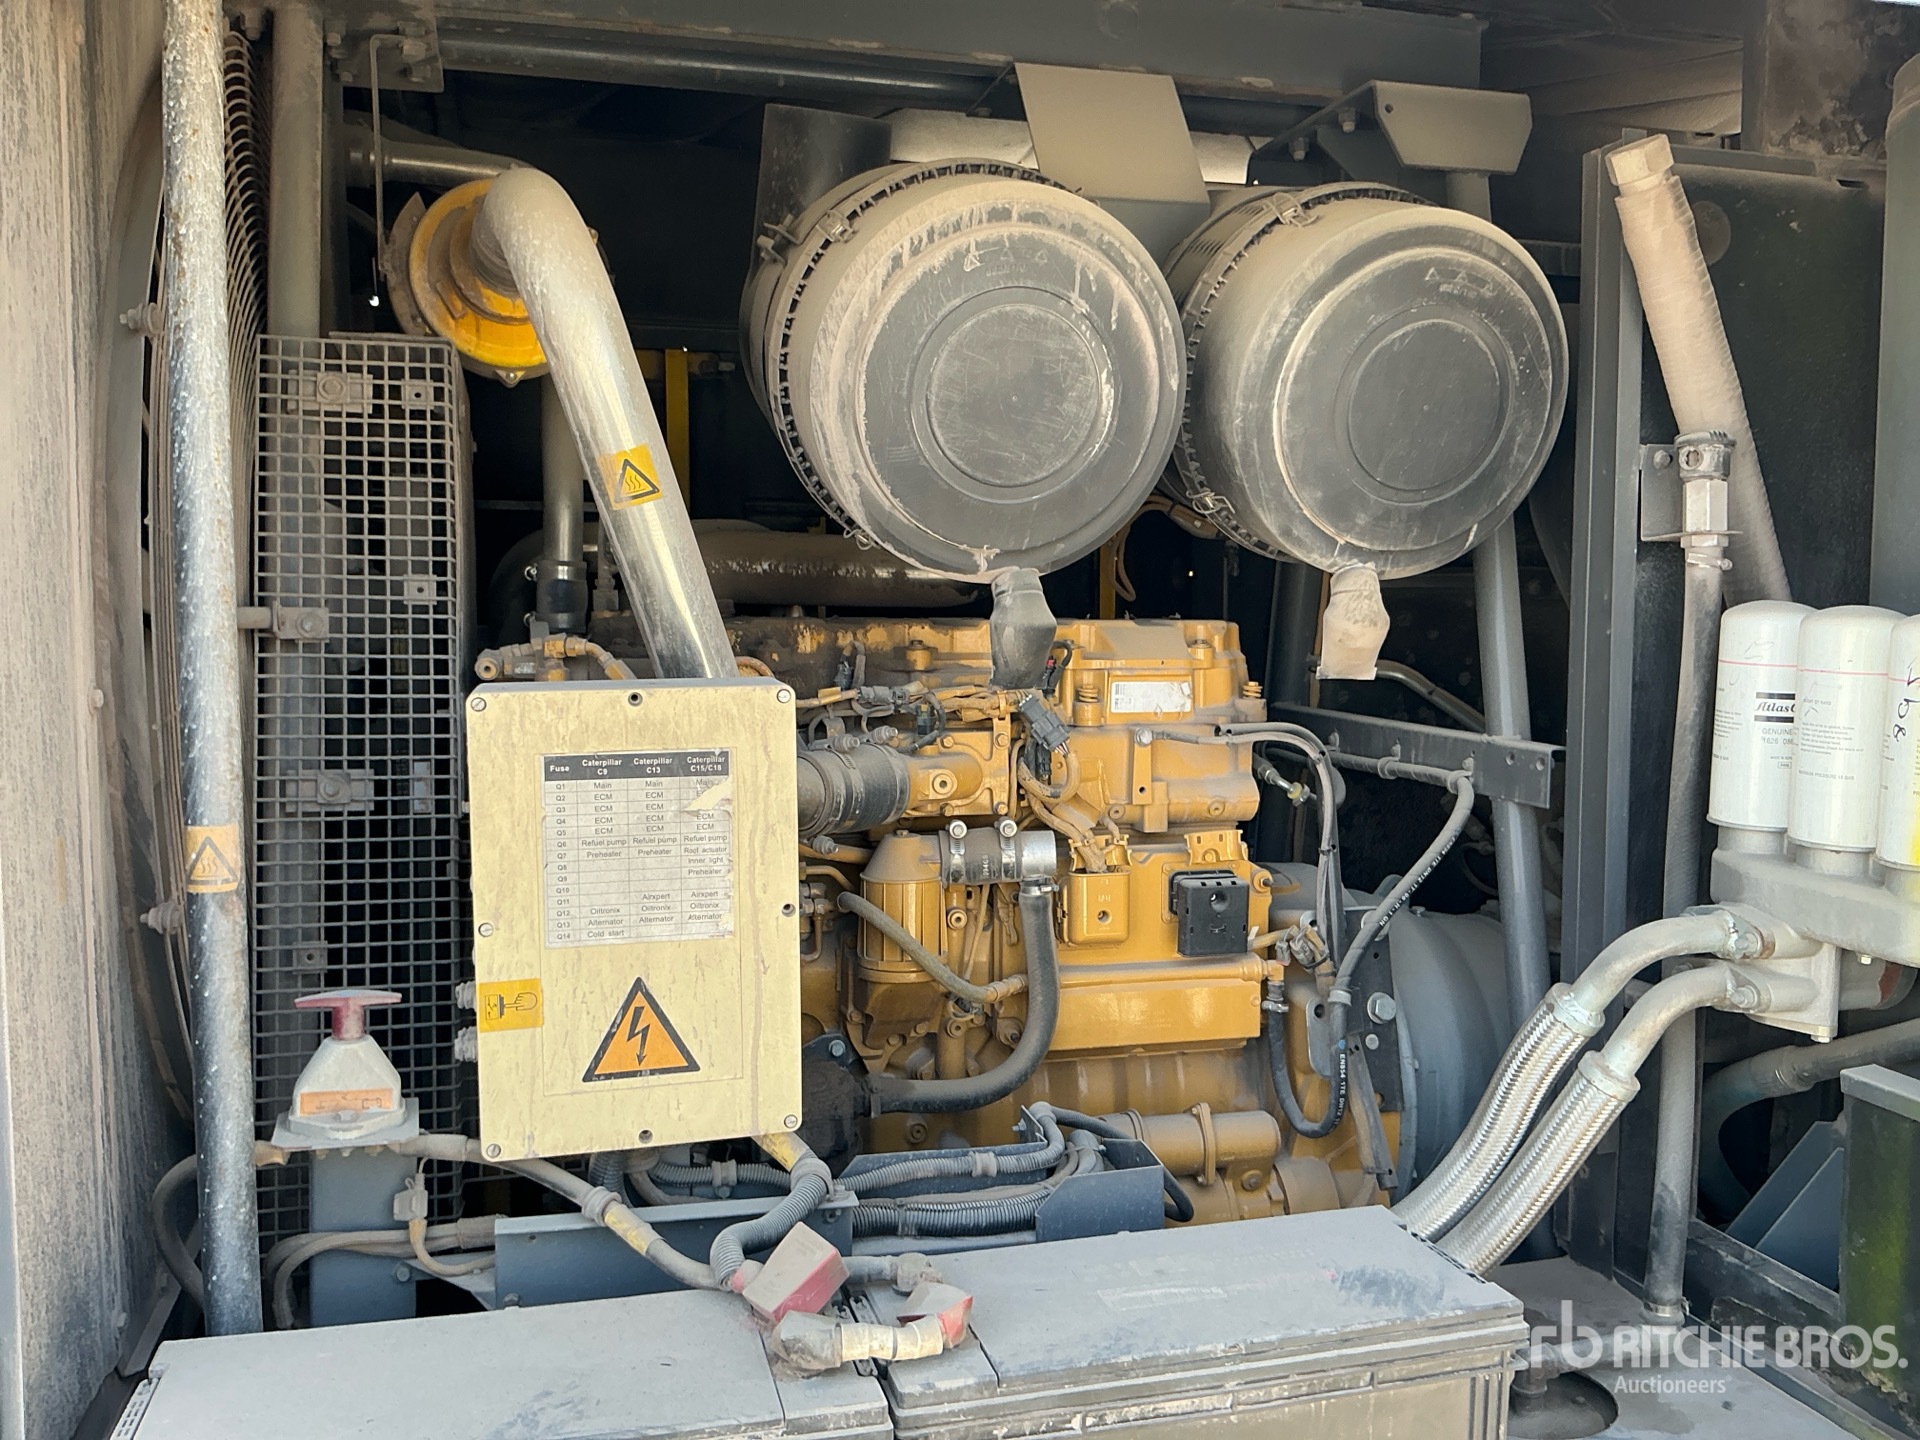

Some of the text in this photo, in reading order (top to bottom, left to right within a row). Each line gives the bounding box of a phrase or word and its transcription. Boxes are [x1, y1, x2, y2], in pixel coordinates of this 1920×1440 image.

[582, 756, 726, 768] Caterpillar Caterpillar Caterpillar
[549, 764, 570, 772] Fuse
[596, 764, 722, 776] C9 C13 C15/C18
[645, 780, 663, 788] Main
[556, 794, 566, 802] Q2
[556, 806, 566, 814] Q3
[594, 816, 613, 824] ECM
[646, 814, 664, 822] ECM
[696, 812, 714, 820] ECM
[606, 839, 627, 847] pump
[658, 836, 678, 844] pump
[708, 834, 728, 842] pump
[557, 852, 567, 860] Q7
[638, 848, 672, 856] Preheater
[702, 846, 728, 854] actuator
[708, 856, 724, 864] light
[688, 868, 722, 876] Preheater
[556, 890, 719, 906] Q11 Airxpert Airxpert
[641, 904, 671, 912] Oiltronix
[690, 902, 720, 910] Oiltronix
[587, 930, 604, 938] Cold
